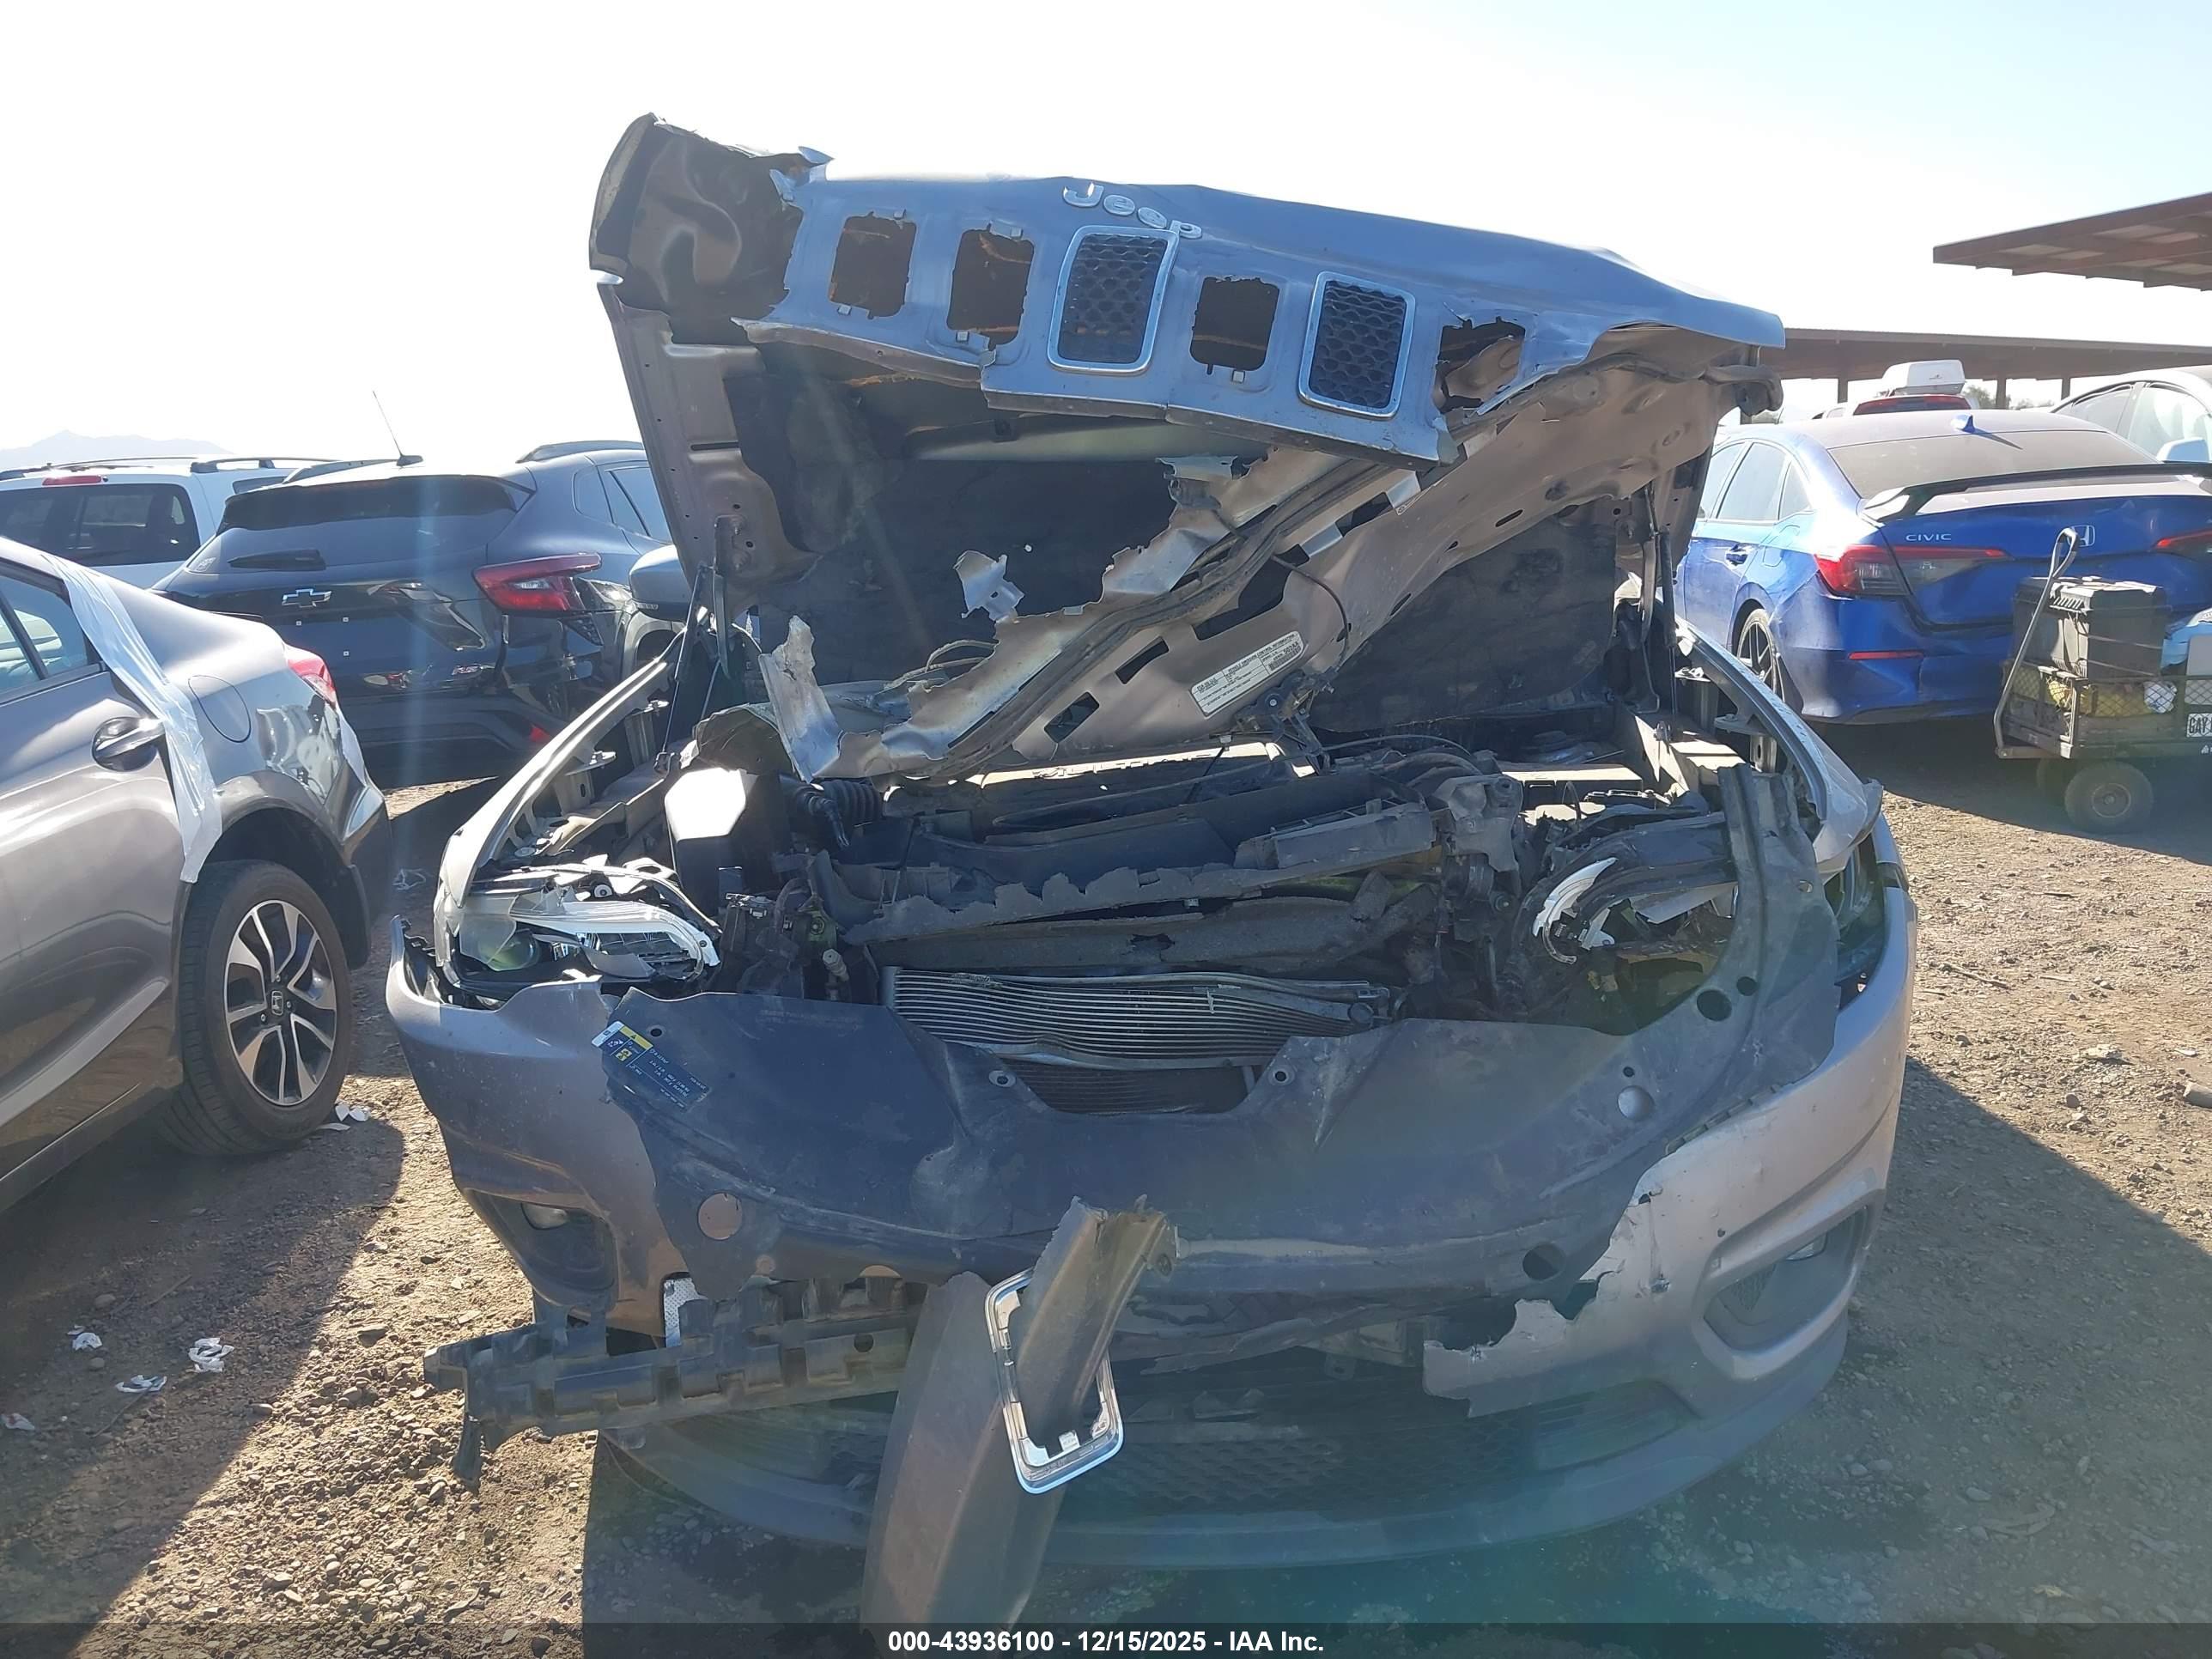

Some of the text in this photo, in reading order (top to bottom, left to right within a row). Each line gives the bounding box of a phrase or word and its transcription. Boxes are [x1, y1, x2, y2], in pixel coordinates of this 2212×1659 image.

[1062, 182, 1202, 239] Jeep
[1905, 533, 1952, 542] CIVIC
[2190, 716, 2212, 734] GAY
